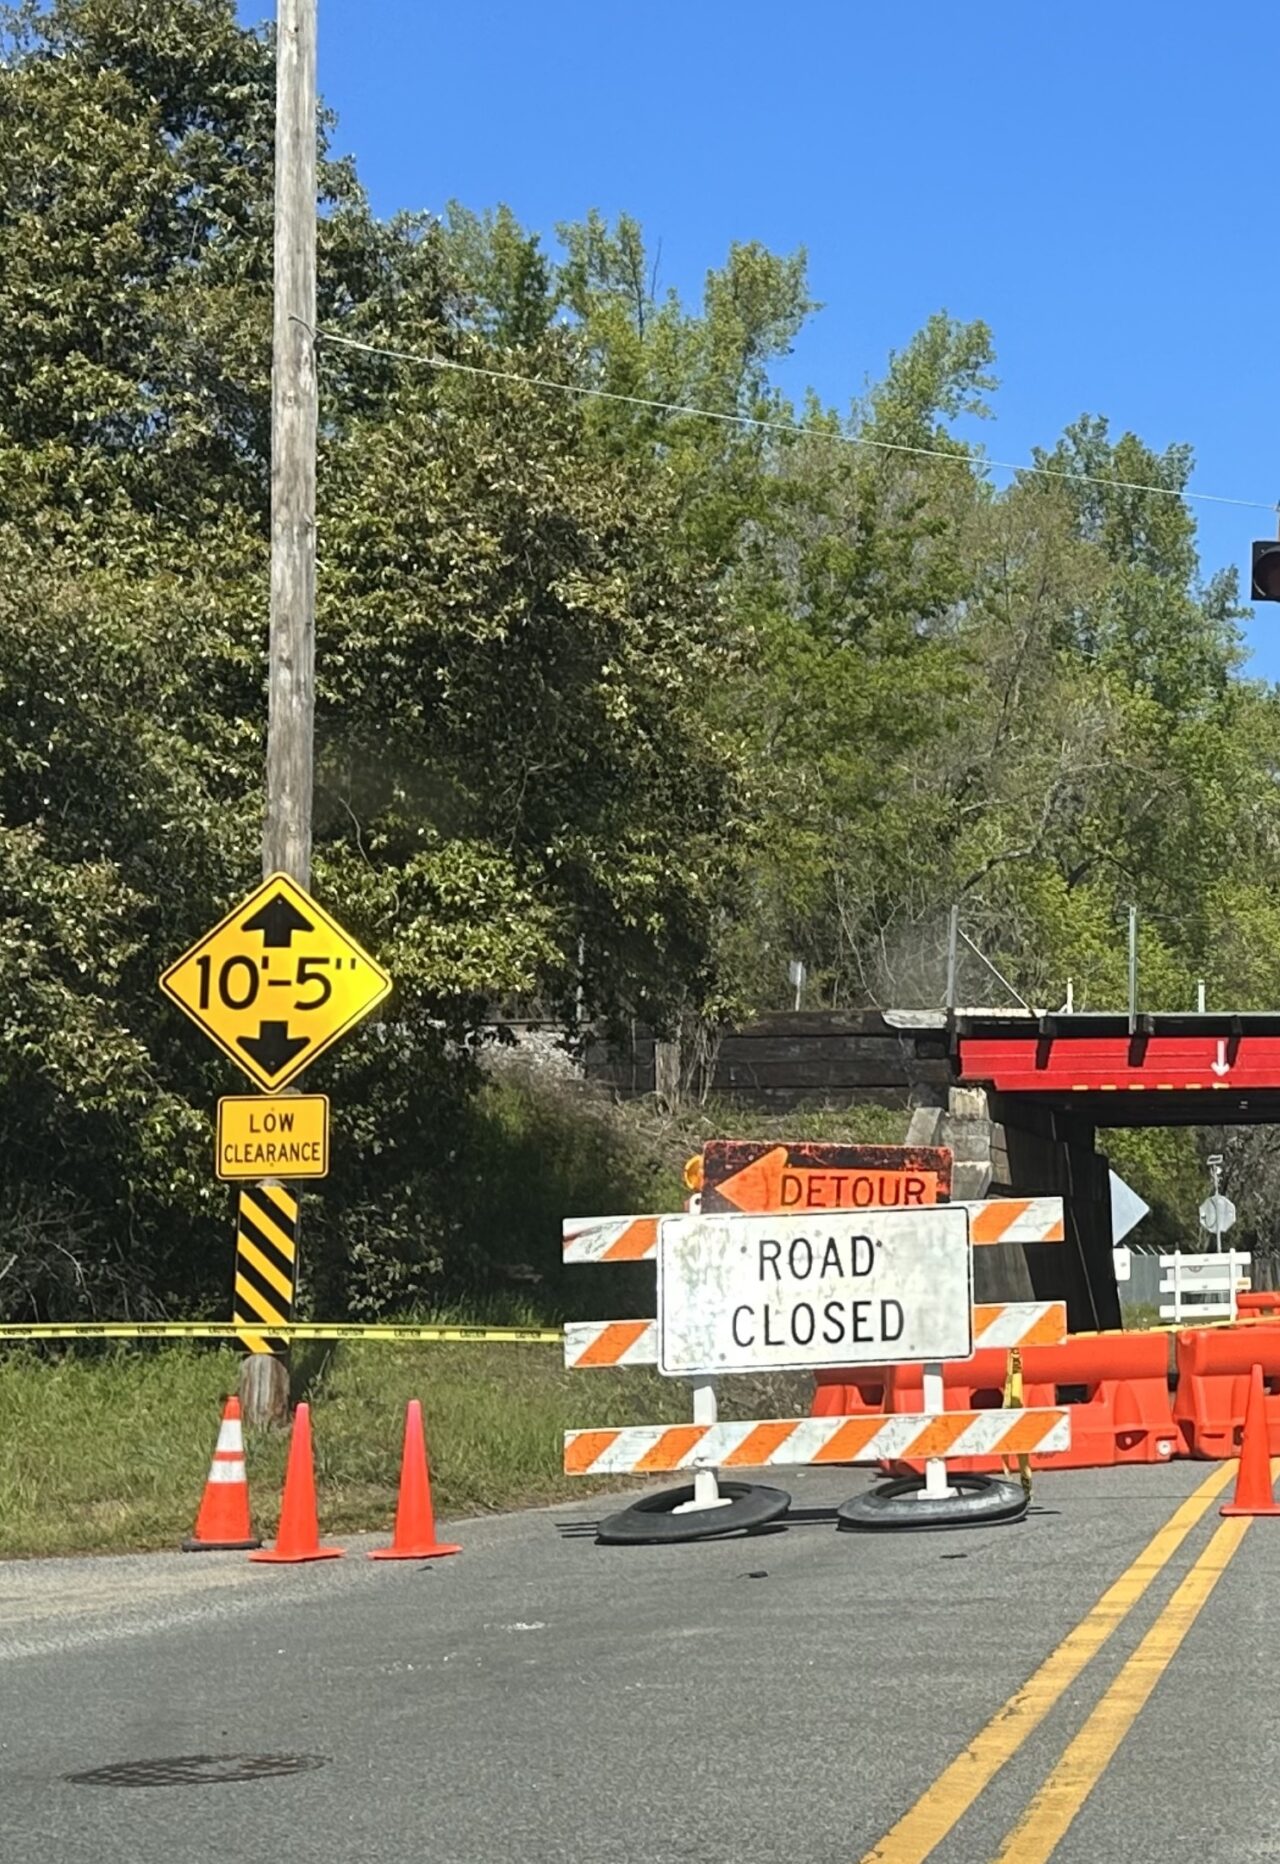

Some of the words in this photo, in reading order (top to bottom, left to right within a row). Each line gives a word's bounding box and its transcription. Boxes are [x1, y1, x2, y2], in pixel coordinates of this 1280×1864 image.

[249, 1113, 294, 1133] LOW
[223, 1142, 321, 1164] CLEARANCE
[780, 1174, 926, 1207] DETOUR
[758, 1235, 876, 1281] ROAD
[732, 1299, 905, 1348] CLOSED
